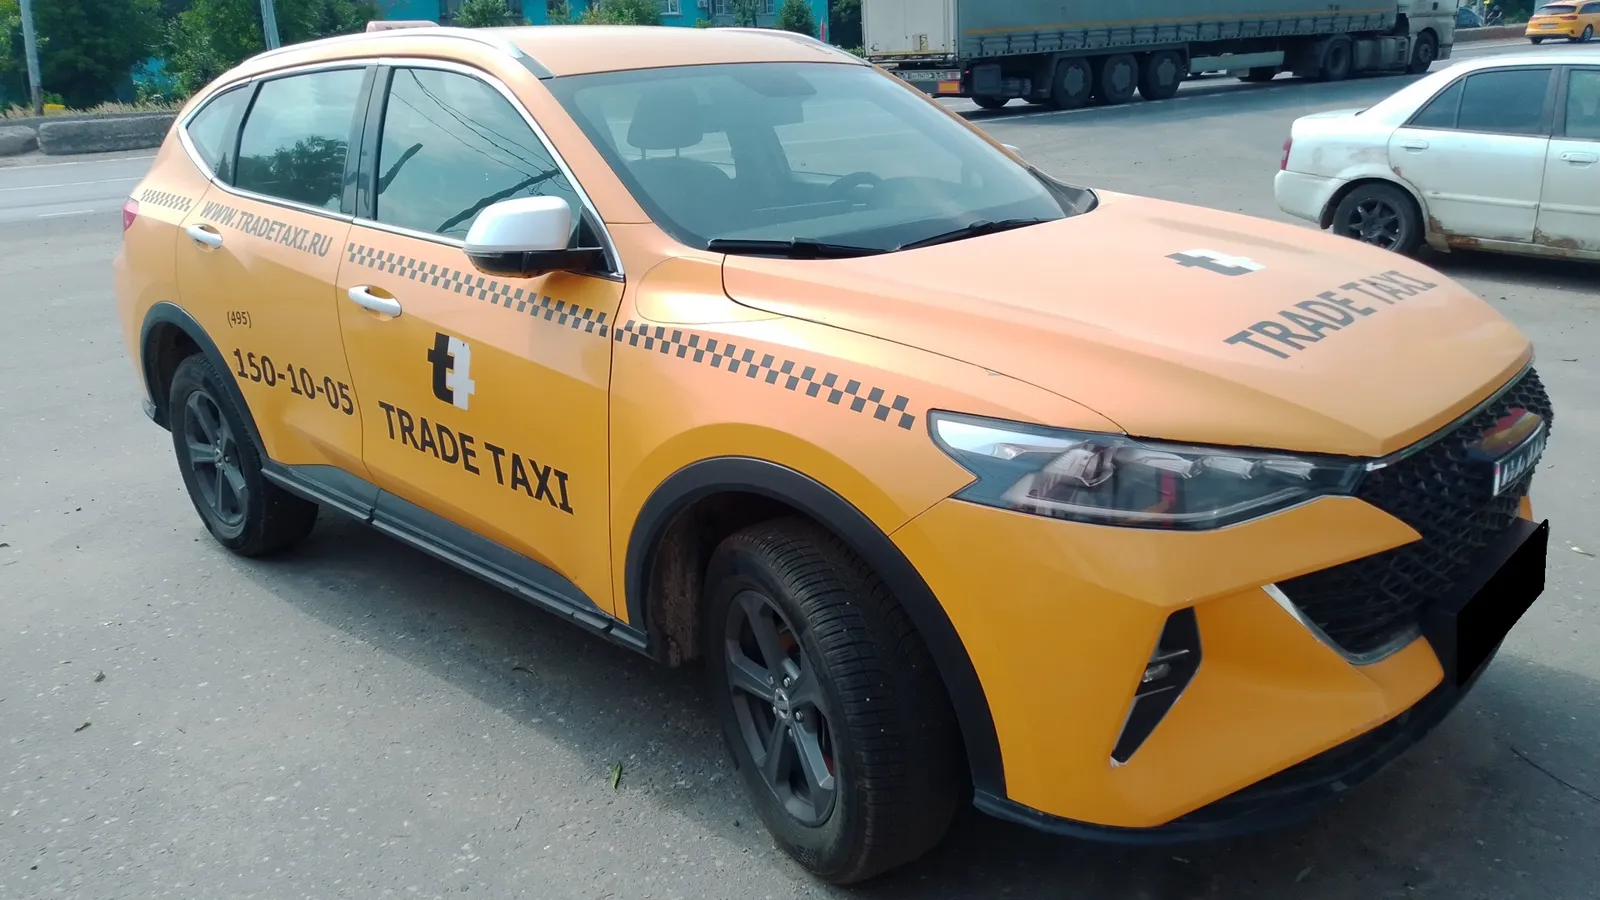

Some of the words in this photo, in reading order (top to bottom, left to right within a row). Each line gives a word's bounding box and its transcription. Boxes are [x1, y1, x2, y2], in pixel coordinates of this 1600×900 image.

[200, 201, 333, 257] WWW.TRADETAXI.RU
[227, 311, 252, 328] (495)
[1223, 291, 1377, 359] TRADE
[1339, 270, 1438, 305] TAXI
[233, 348, 354, 415] 150-10-05
[378, 401, 480, 476] TRADE
[484, 441, 574, 515] TAXI
